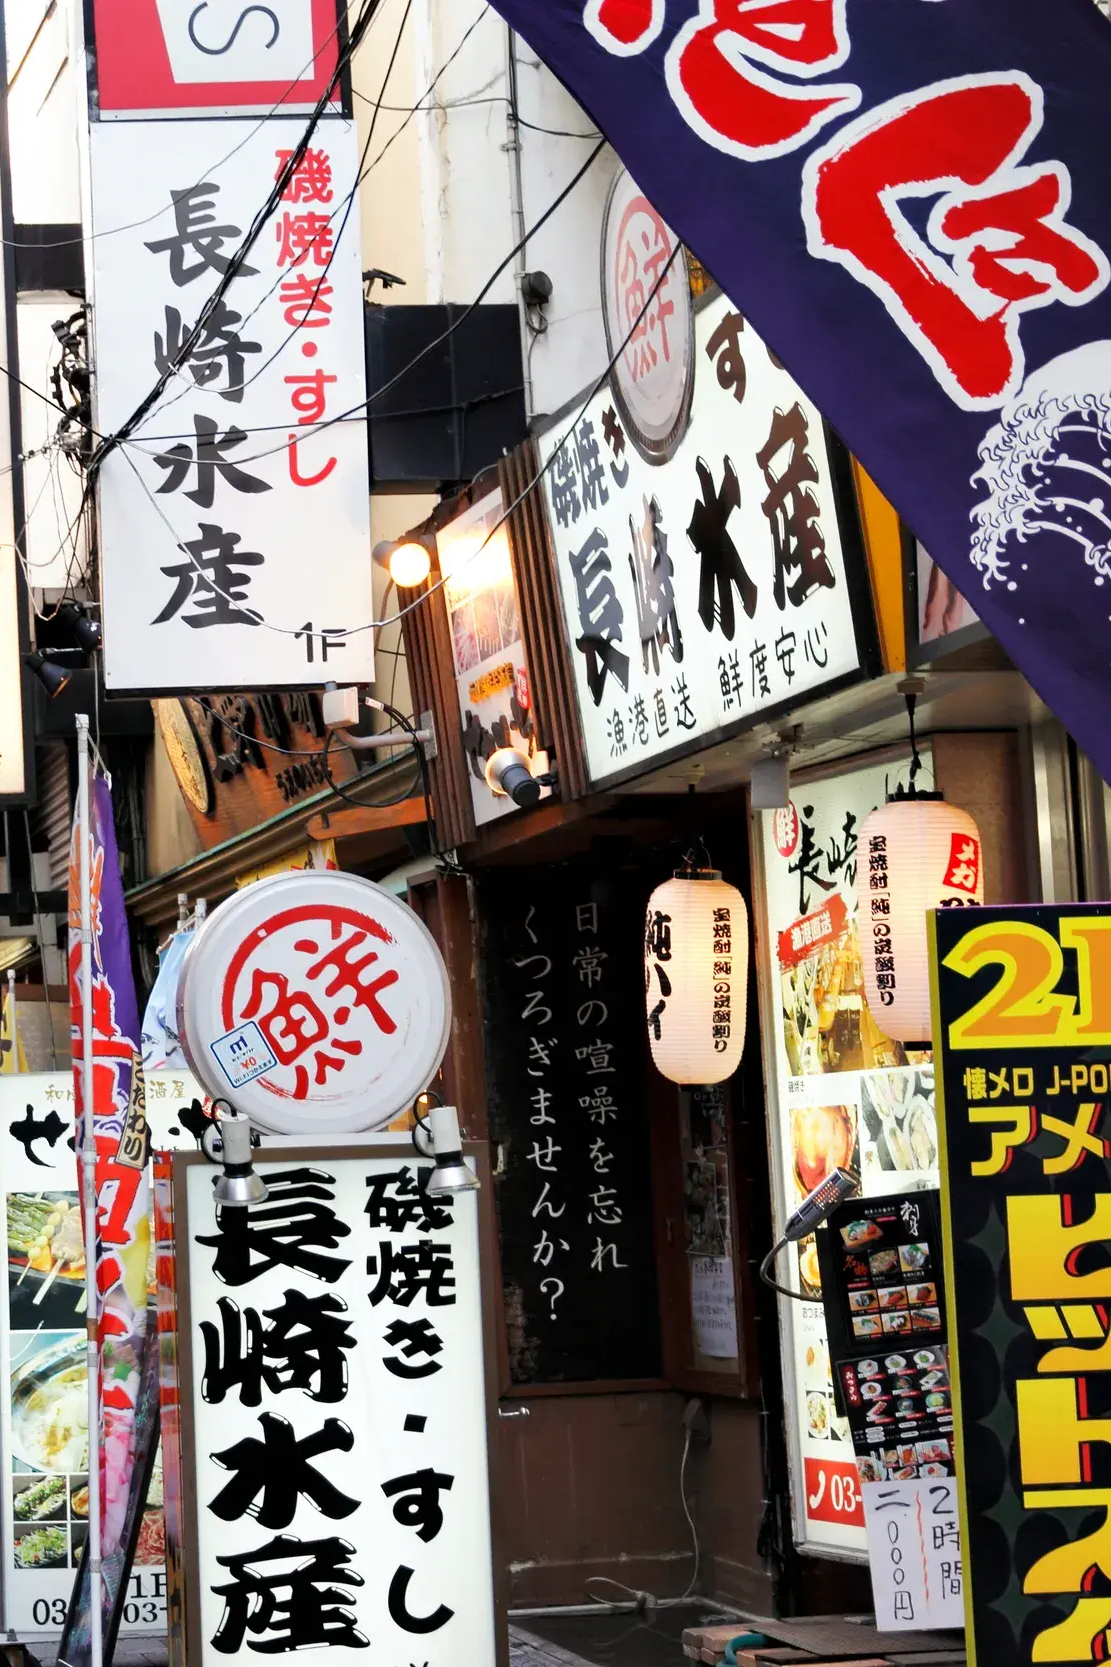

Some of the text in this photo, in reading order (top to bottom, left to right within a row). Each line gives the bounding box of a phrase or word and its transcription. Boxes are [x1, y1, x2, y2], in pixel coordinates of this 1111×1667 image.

[143, 182, 273, 629] 長崎水産
[275, 148, 338, 490] 磯焼き・すし
[548, 404, 630, 529] 磯焼き
[567, 401, 837, 707] 長崎水産
[605, 672, 698, 758] 漁港直送
[717, 620, 829, 712] 鮮度安心
[123, 1057, 147, 1163] こだわり
[963, 1066, 1034, 1101] 懐メロ
[194, 1166, 371, 1655] 長崎水産
[364, 1164, 458, 1635] 磯焼き・すし
